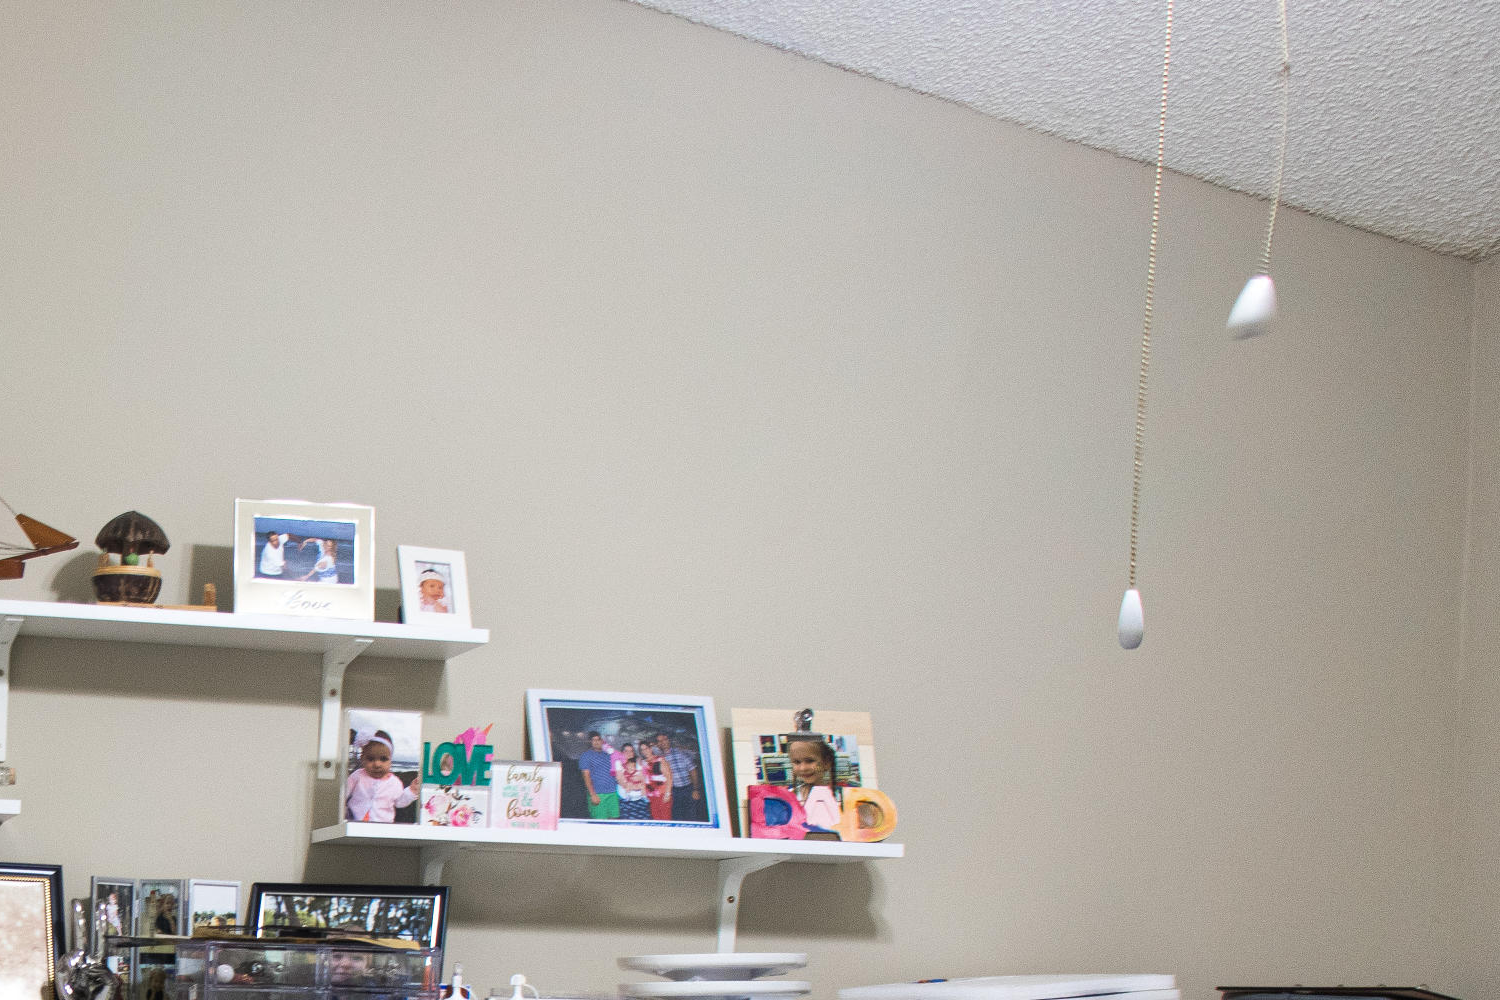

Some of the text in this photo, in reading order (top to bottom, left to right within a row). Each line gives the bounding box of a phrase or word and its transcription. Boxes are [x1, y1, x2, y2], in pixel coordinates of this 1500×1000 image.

[422, 742, 494, 786] LOVE
[506, 763, 544, 793] family
[506, 798, 541, 820] love
[748, 785, 898, 842] DAD
